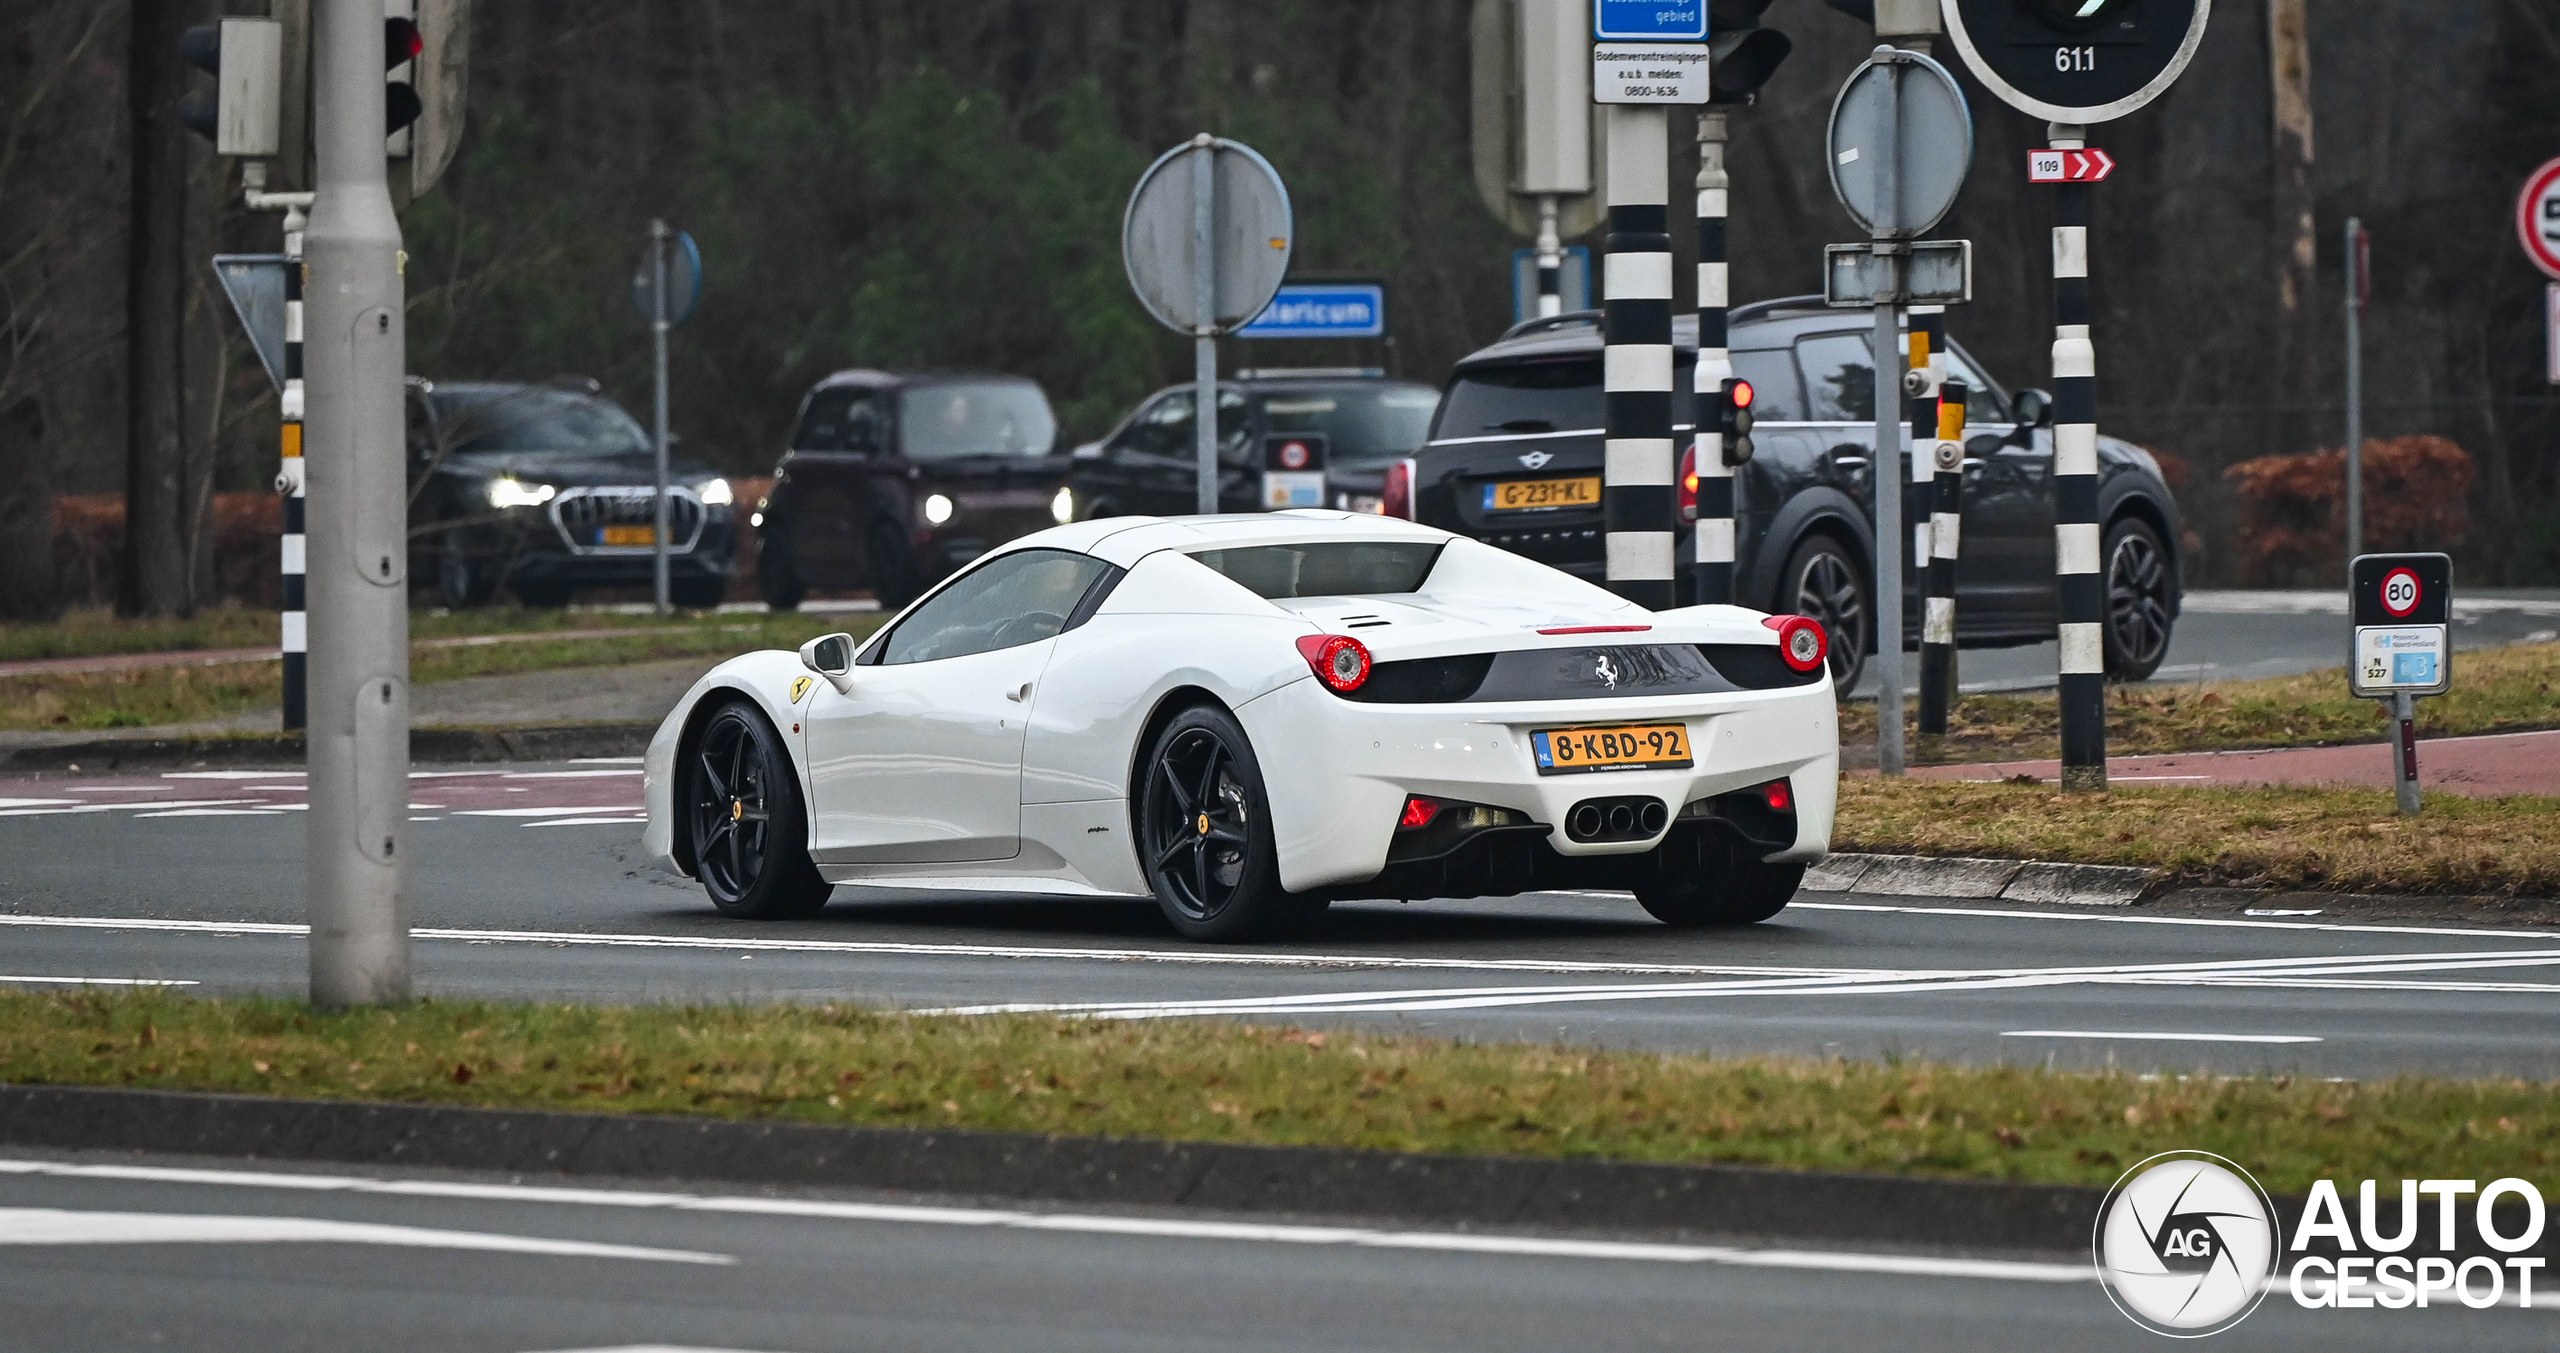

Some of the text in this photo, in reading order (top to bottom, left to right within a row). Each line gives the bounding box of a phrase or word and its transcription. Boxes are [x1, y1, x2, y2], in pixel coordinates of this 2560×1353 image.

[1655, 10, 1695, 25] gebied
[1596, 51, 1708, 64] Bodemverontreinigingen
[2055, 46, 2095, 72] 61.1
[1618, 69, 1645, 79] a.u.b.
[1625, 86, 1679, 97] 0800-1636
[2037, 160, 2059, 172] 109
[1505, 482, 1589, 504] G-231-KL
[2387, 583, 2414, 601] 80
[2373, 657, 2382, 667] N
[2367, 668, 2388, 679] 527
[1556, 731, 1683, 761] 8-KBD-92
[1539, 753, 1551, 762] NL
